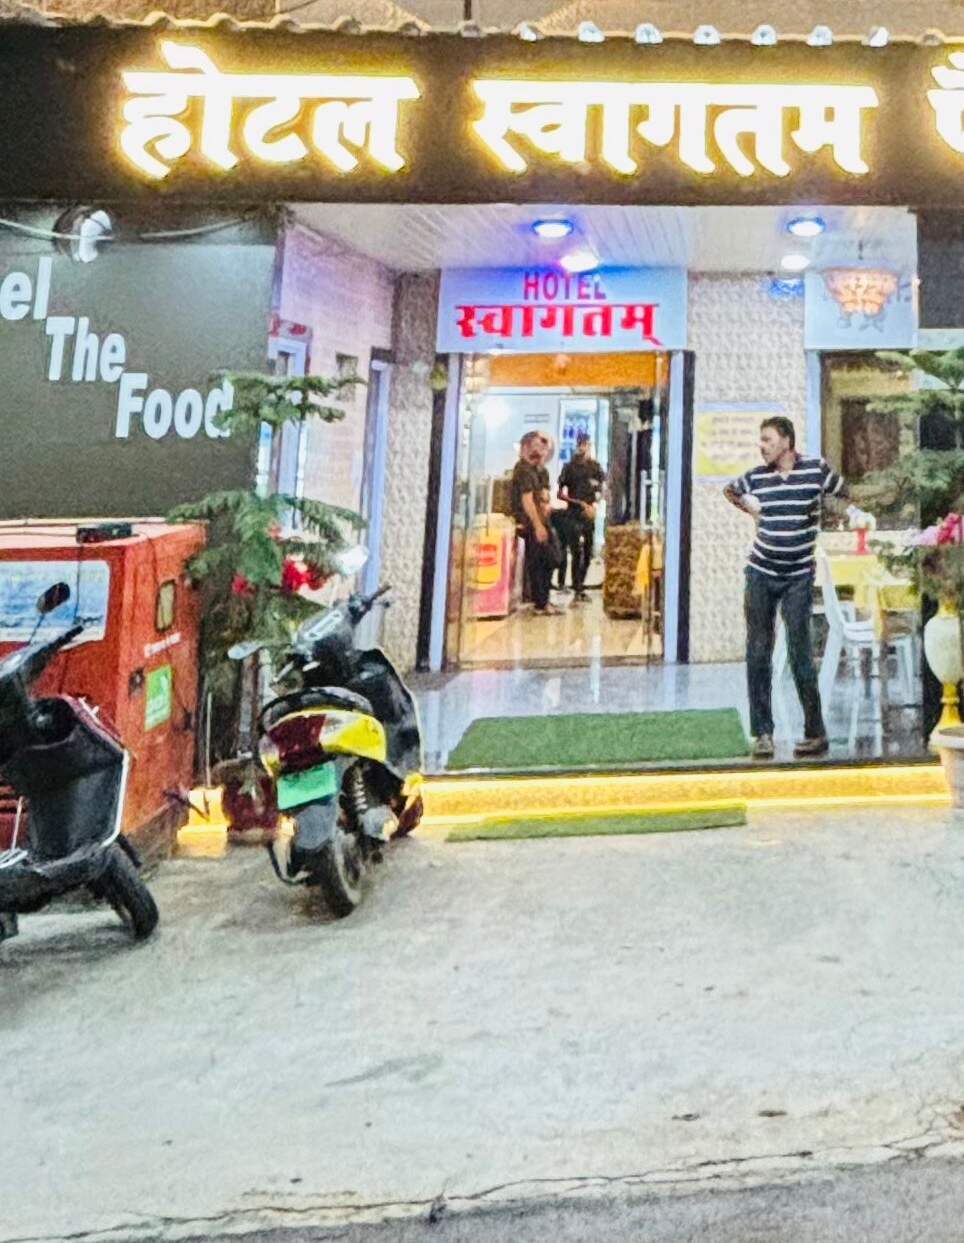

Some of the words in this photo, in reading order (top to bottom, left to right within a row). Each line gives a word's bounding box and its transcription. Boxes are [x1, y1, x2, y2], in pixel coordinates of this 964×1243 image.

[119, 40, 420, 178] होटल
[471, 77, 880, 177] स्वागतम
[522, 271, 606, 300] HOTEL
[46, 316, 126, 383] The
[455, 303, 663, 346] स्वागतम्
[115, 373, 234, 440] Food
